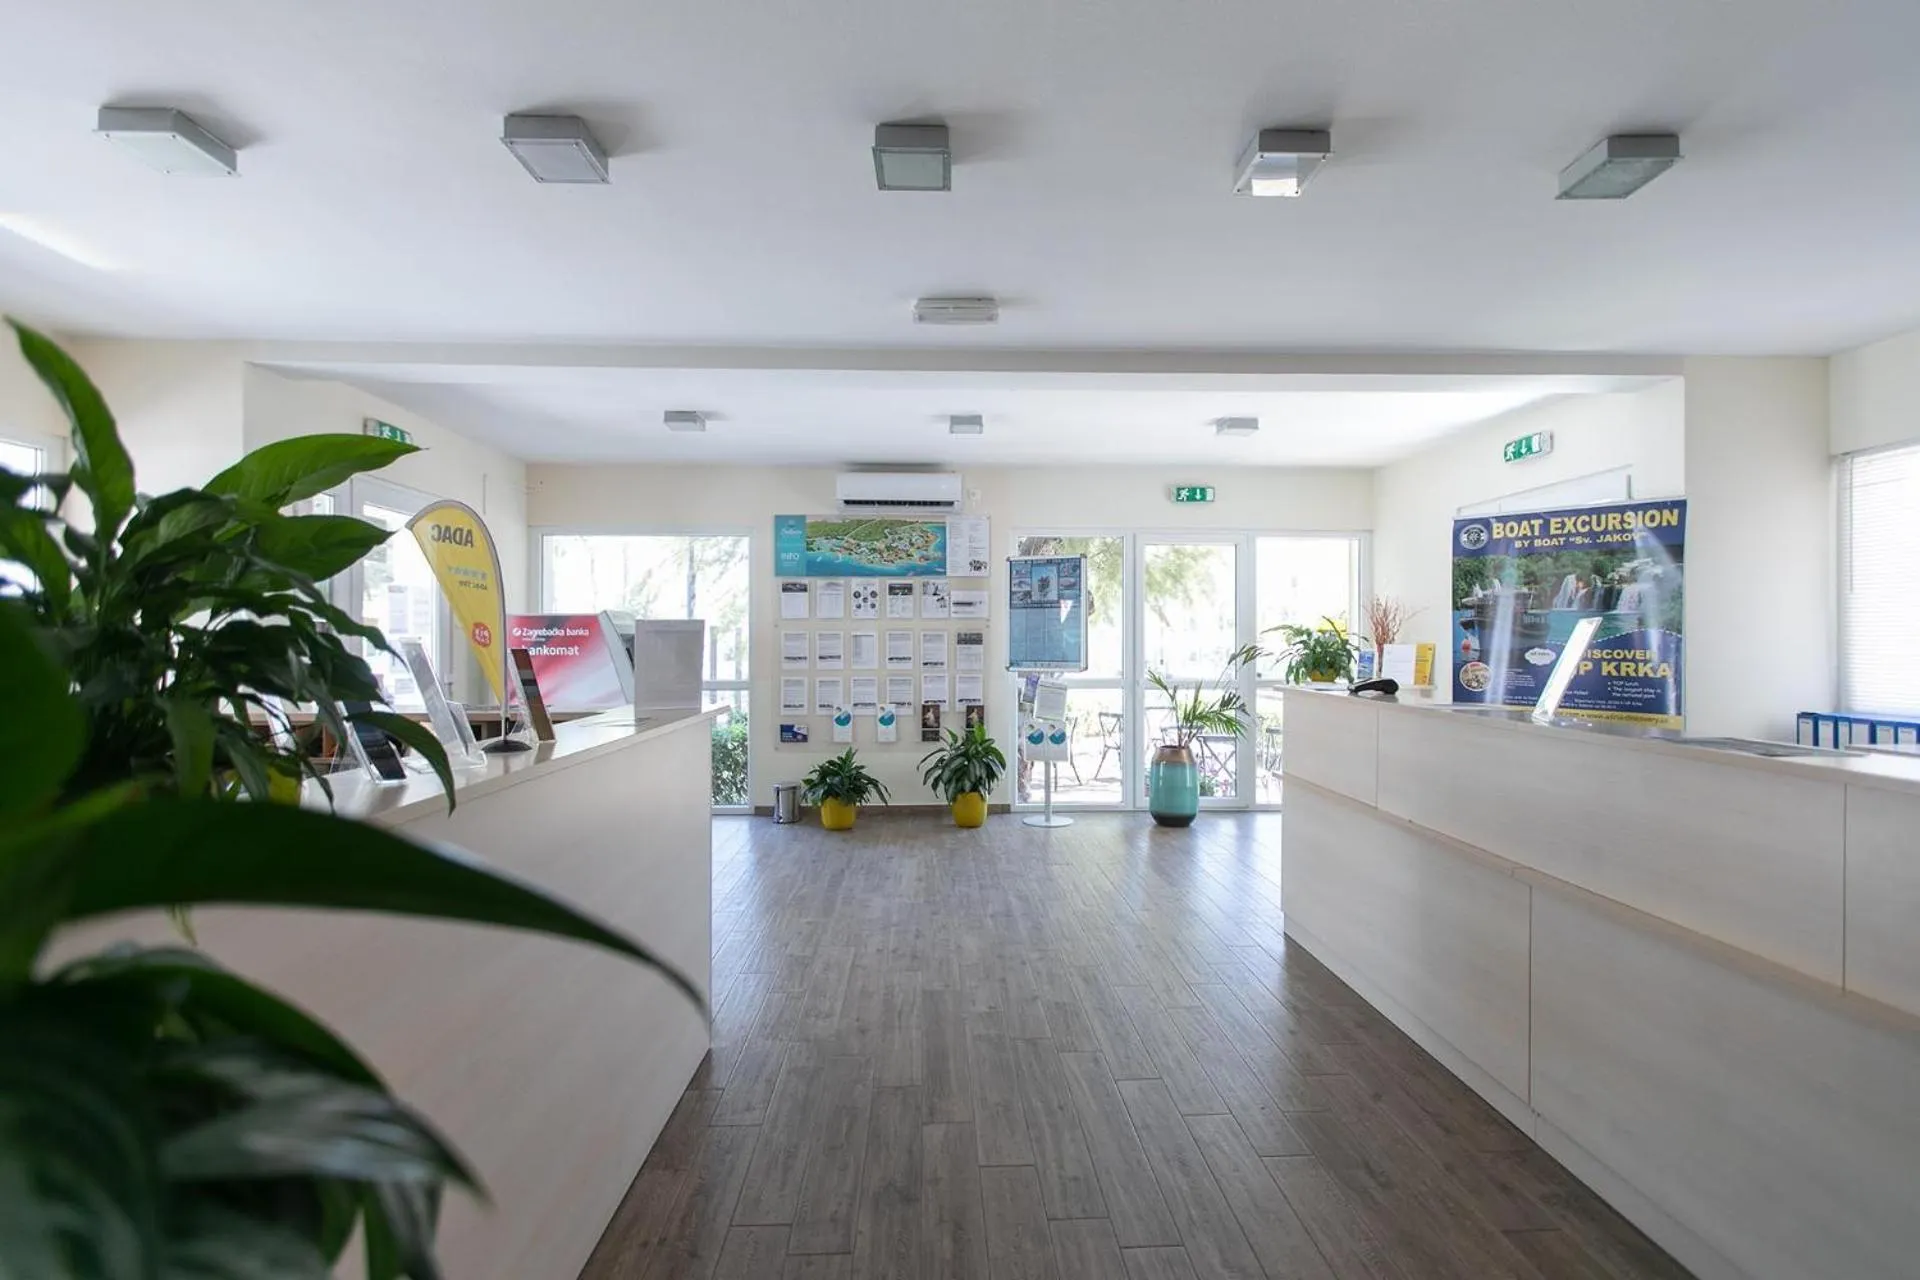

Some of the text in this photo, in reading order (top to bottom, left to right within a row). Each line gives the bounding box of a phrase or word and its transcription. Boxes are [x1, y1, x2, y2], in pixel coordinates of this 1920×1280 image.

[1492, 519, 1544, 540] BOAT
[1550, 508, 1680, 535] EXCURSION
[1514, 540, 1530, 548] BY
[1534, 537, 1566, 547] BOAT
[566, 627, 590, 637] banka
[1602, 661, 1672, 678] KRKA
